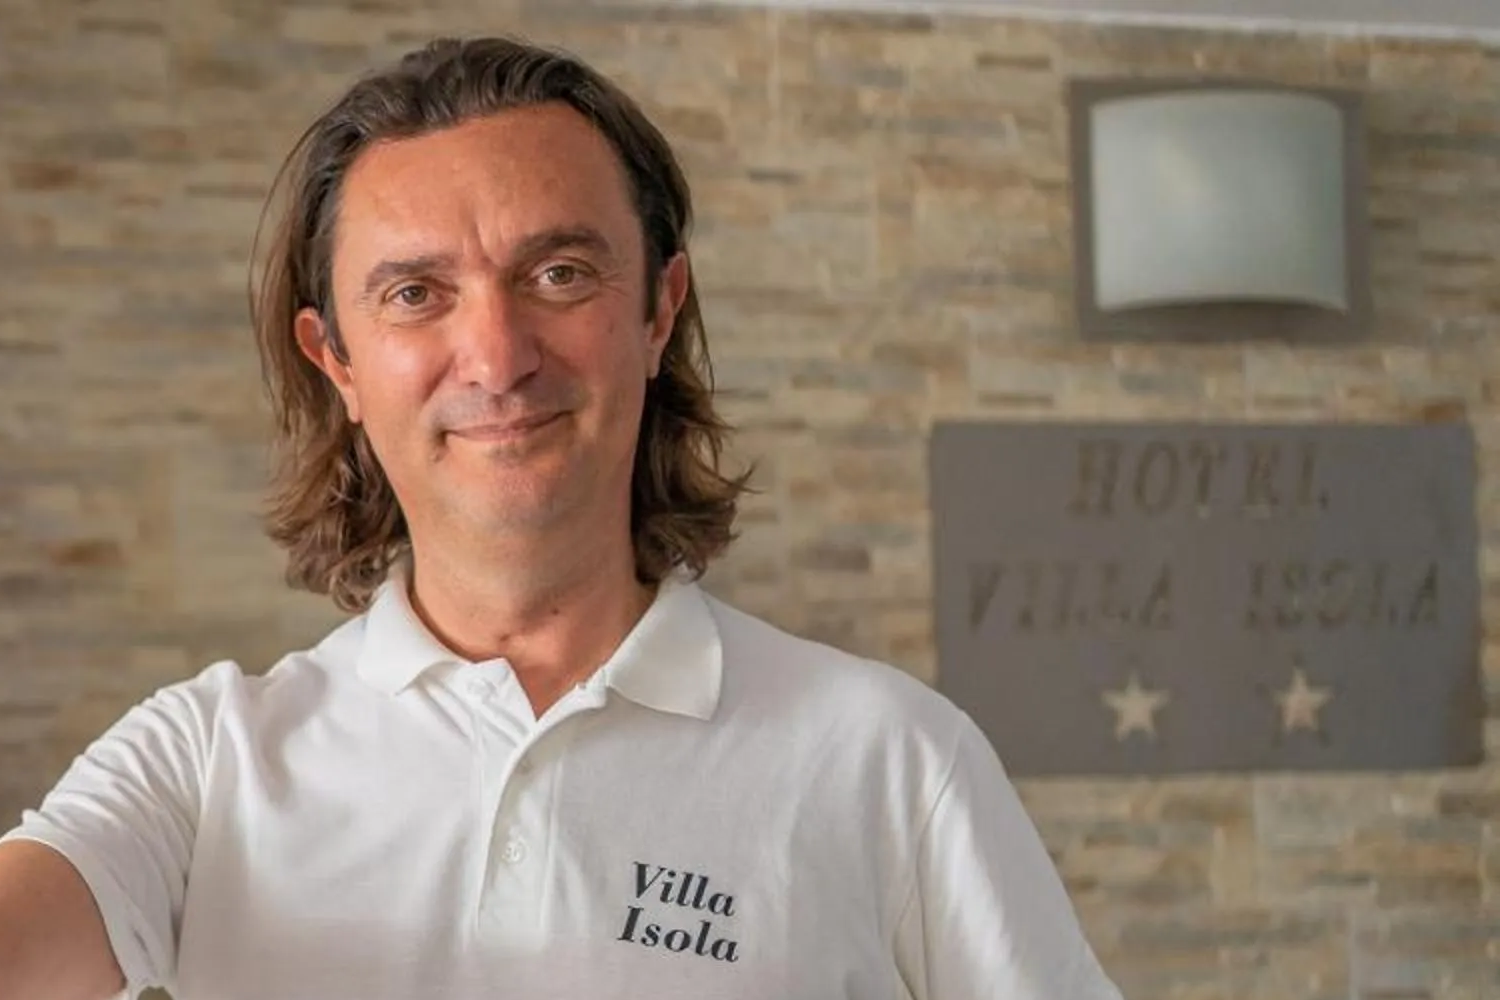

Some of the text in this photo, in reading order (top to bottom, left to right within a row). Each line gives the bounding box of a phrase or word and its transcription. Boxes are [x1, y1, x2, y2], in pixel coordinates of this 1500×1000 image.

[1065, 438, 1330, 518] HOTEL
[965, 557, 1441, 636] VILLA ISOLA
[632, 861, 736, 917] Villa
[616, 905, 739, 963] Isola
